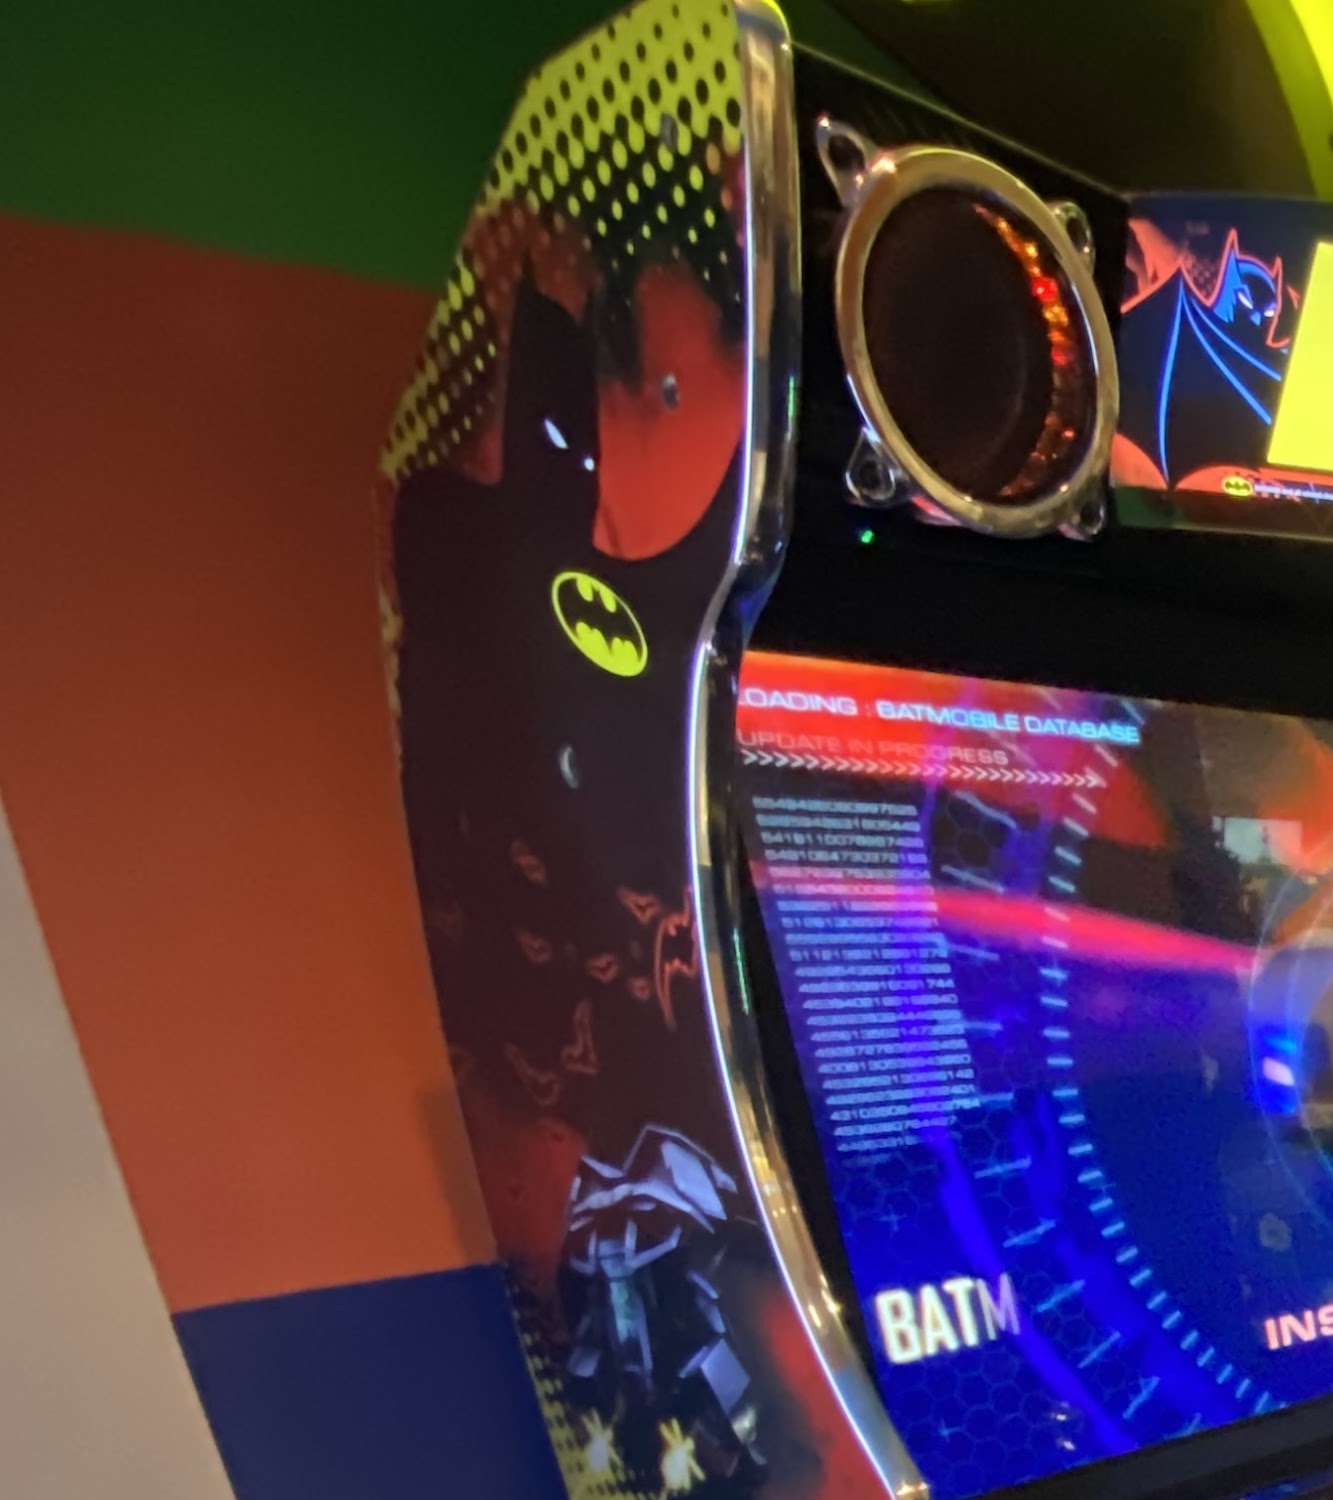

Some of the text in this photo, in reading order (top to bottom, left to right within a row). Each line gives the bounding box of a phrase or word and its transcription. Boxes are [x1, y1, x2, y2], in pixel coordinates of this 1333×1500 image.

[876, 700, 1020, 732] BATMOBILE
[1024, 714, 1141, 745] DATABASE
[736, 729, 1009, 766] UPDATE IN PROGRESS
[874, 1271, 1021, 1365] BATM
